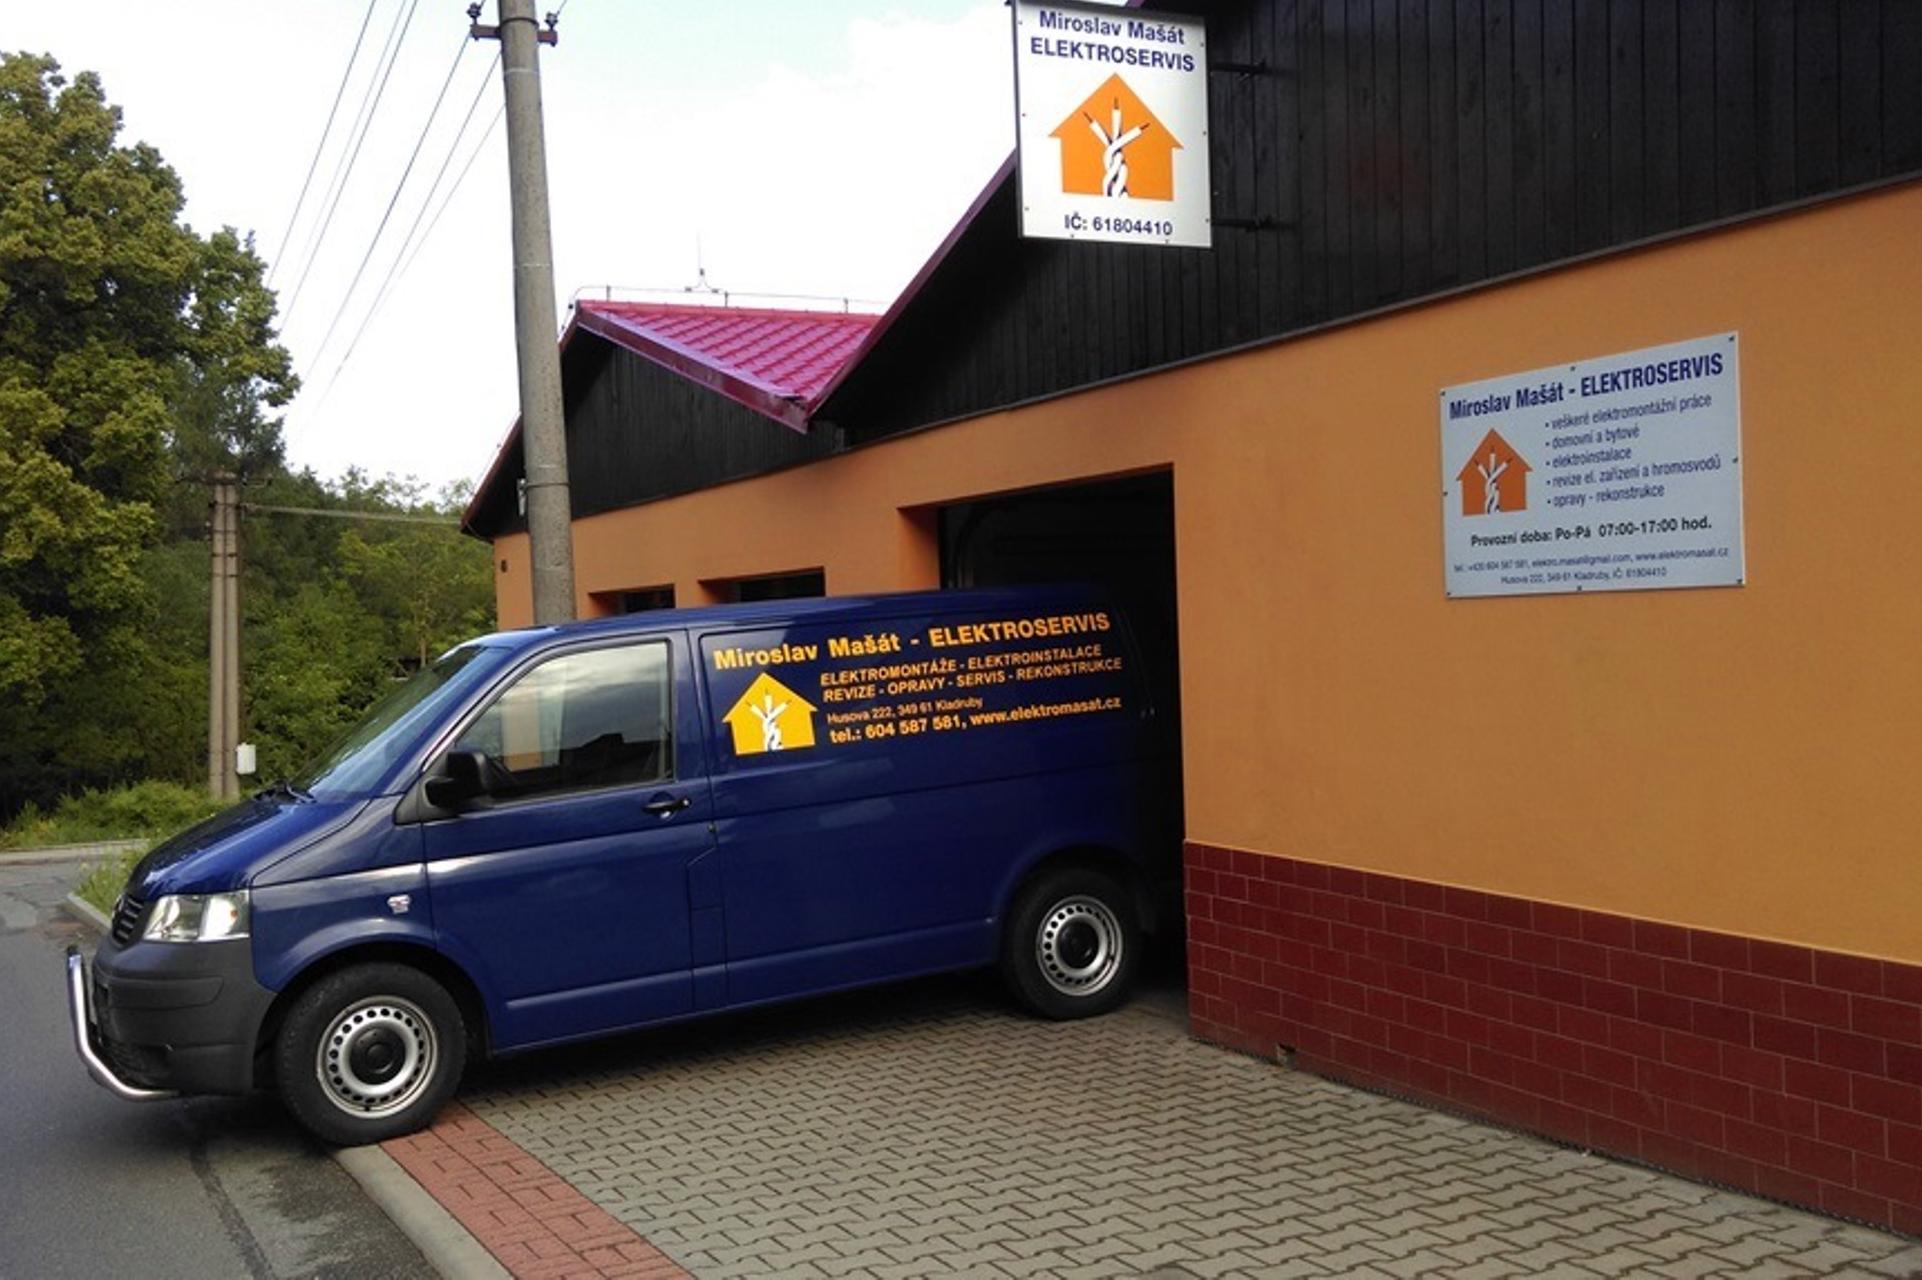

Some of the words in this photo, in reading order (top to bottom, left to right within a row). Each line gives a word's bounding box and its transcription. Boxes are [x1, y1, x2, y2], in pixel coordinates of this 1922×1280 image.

[1040, 10, 1121, 36] Miroslav
[1128, 21, 1185, 44] Mašát
[1031, 37, 1195, 72] ELEKTROSERVIS
[1064, 212, 1087, 230] IČ:
[1093, 216, 1173, 236] 61804410
[1449, 394, 1511, 420] Miroslav
[1516, 382, 1564, 408] Mašát
[1581, 352, 1723, 397] ELEKTROSERVIS
[1551, 412, 1589, 429] veškeré
[1593, 399, 1677, 423] elektromontážní
[1680, 393, 1712, 411] práce
[1552, 428, 1593, 449] domovní
[1596, 431, 1602, 442] a
[1606, 423, 1640, 442] bytové
[1552, 447, 1632, 468] elektroinstalace
[1552, 472, 1582, 487] revize
[1584, 471, 1596, 484] el.
[1599, 463, 1640, 481] zařízení
[1642, 466, 1649, 476] a
[1652, 454, 1721, 476] hromosvodů
[1553, 491, 1586, 507] opravy
[1596, 484, 1665, 502] rekonstrukce
[1471, 532, 1517, 547] Provozní
[1521, 530, 1552, 543] doba:
[1555, 525, 1591, 540] Po-Pá
[1598, 518, 1678, 538] 07:00-17:00
[1682, 516, 1712, 531] hod.
[713, 644, 818, 670] Miroslav
[828, 633, 901, 658] Mašát
[928, 612, 1111, 647] ELEKTROSERVIS
[820, 657, 957, 686] ELEKTROMONTÁŽE
[968, 644, 1102, 670] ELEKTROINSTALACE
[823, 684, 876, 702] REVIZE
[887, 677, 946, 695] OPRAVY
[956, 670, 1006, 688] SERVIS
[1016, 657, 1122, 681] REKONSTRUKCE
[827, 711, 871, 725] Husova
[898, 703, 918, 716] 349
[920, 702, 932, 713] 61
[935, 697, 983, 711] Kladruby
[830, 728, 862, 744] tel.:
[865, 722, 896, 739] 604
[900, 718, 928, 735] 587
[932, 714, 967, 731] 581,
[969, 697, 1122, 727] www.elektromasat.cz
